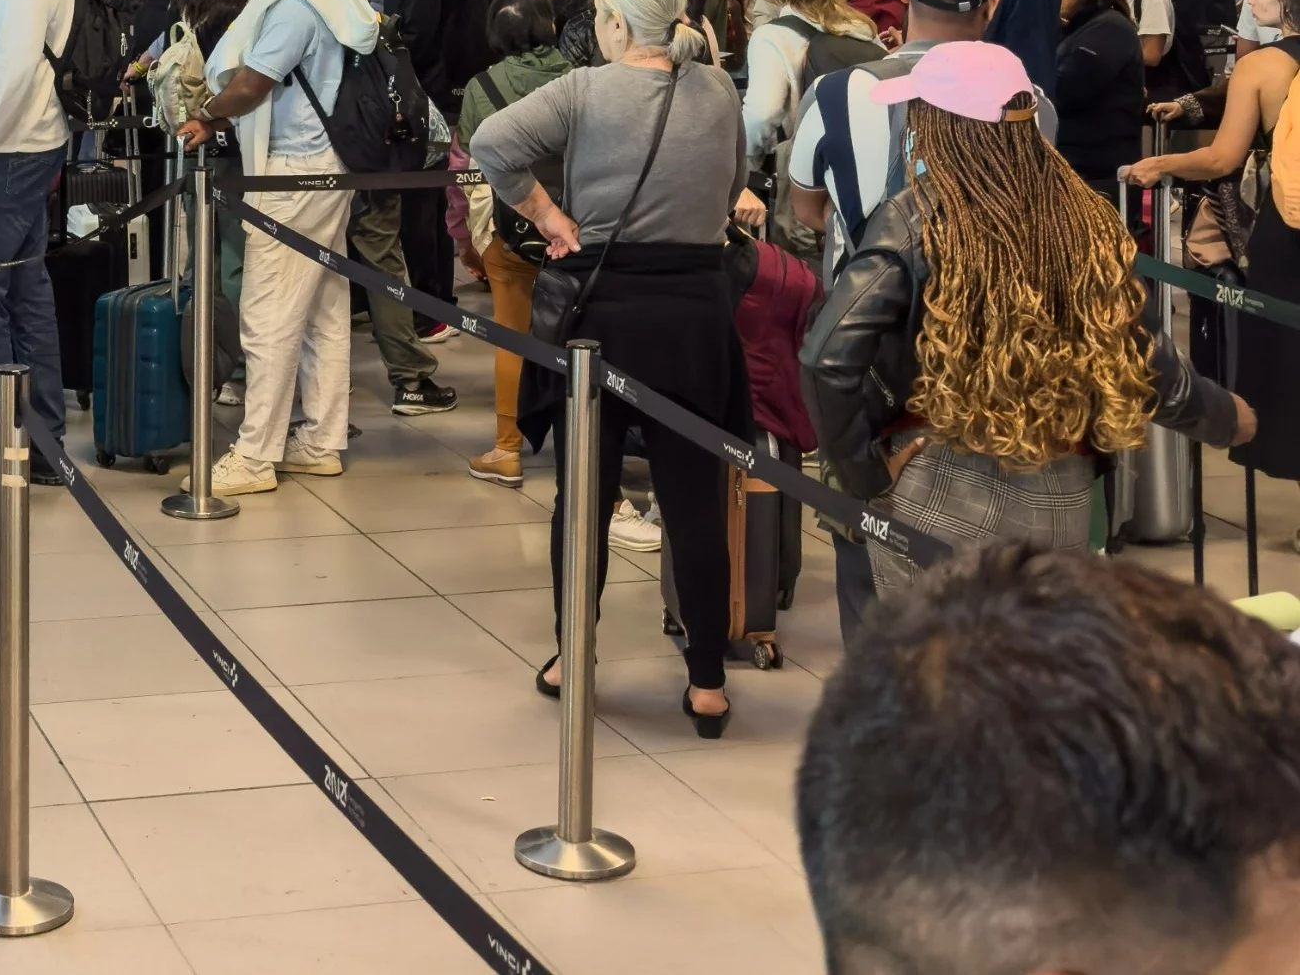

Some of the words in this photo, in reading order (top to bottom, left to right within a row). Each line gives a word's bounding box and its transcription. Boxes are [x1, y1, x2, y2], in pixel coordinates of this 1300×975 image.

[555, 356, 568, 367] VIN
[402, 392, 424, 401] HOKA
[723, 442, 745, 460] VINCI
[212, 650, 231, 675] VINCI
[487, 933, 520, 974] VINCI
